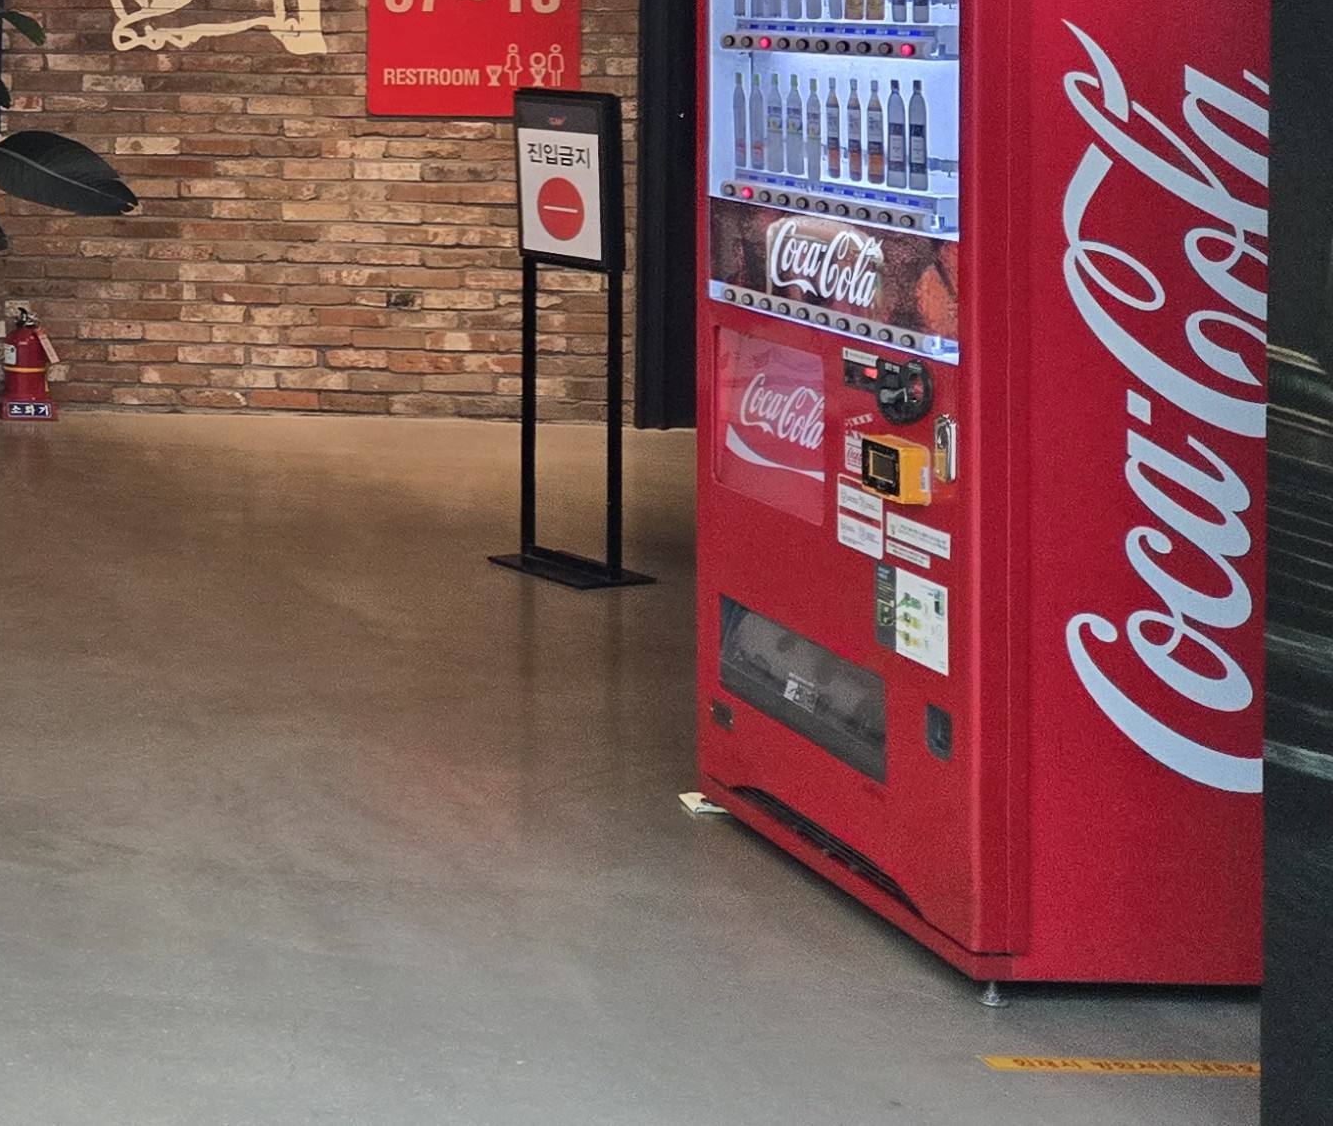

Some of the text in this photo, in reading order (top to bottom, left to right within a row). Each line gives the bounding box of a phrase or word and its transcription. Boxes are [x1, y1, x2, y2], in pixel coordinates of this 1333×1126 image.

[383, 68, 480, 86] RESTROOM
[526, 142, 591, 170] 진입금지
[10, 404, 50, 416] 소화기
